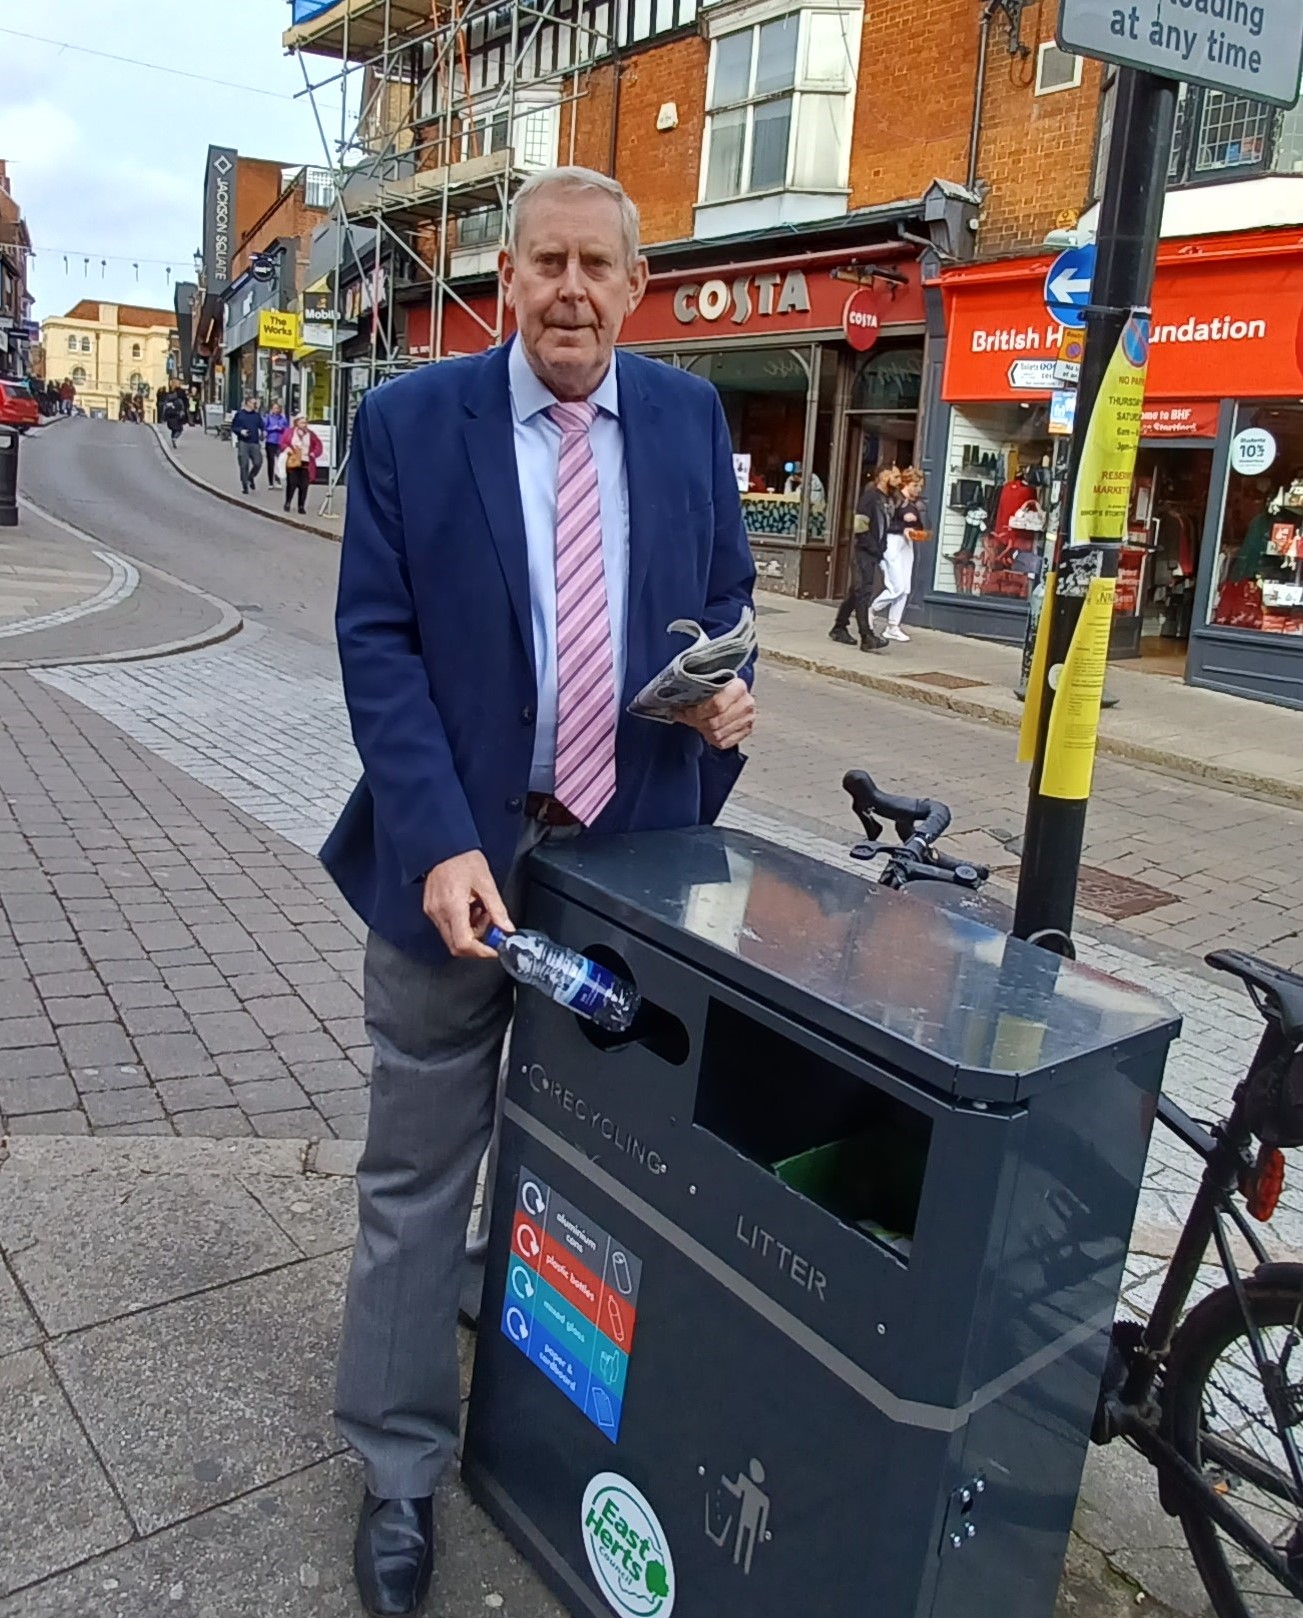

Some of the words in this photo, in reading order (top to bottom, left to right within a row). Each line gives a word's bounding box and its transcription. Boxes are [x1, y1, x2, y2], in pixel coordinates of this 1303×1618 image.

[1110, 6, 1140, 40] at
[1149, 20, 1197, 61] any
[1207, 29, 1262, 73] time
[1170, 0, 1264, 36] ading
[217, 178, 229, 233] JACKSON
[215, 234, 228, 280] SQUARE
[674, 270, 811, 324] COSTA
[849, 311, 878, 328] COSTA
[263, 325, 293, 336] Works
[269, 315, 287, 326] The
[972, 327, 1040, 353] British
[1148, 316, 1266, 344] undation
[1170, 408, 1192, 420] BHF
[550, 1081, 661, 1175] RECYCLING
[556, 1213, 597, 1251] aluminium
[546, 1254, 569, 1279] plastic
[569, 1272, 595, 1302] bottles
[736, 1215, 827, 1302] LITTER
[585, 1507, 643, 1581] Herts
[602, 1498, 650, 1561] East
[599, 1546, 633, 1586] Council
